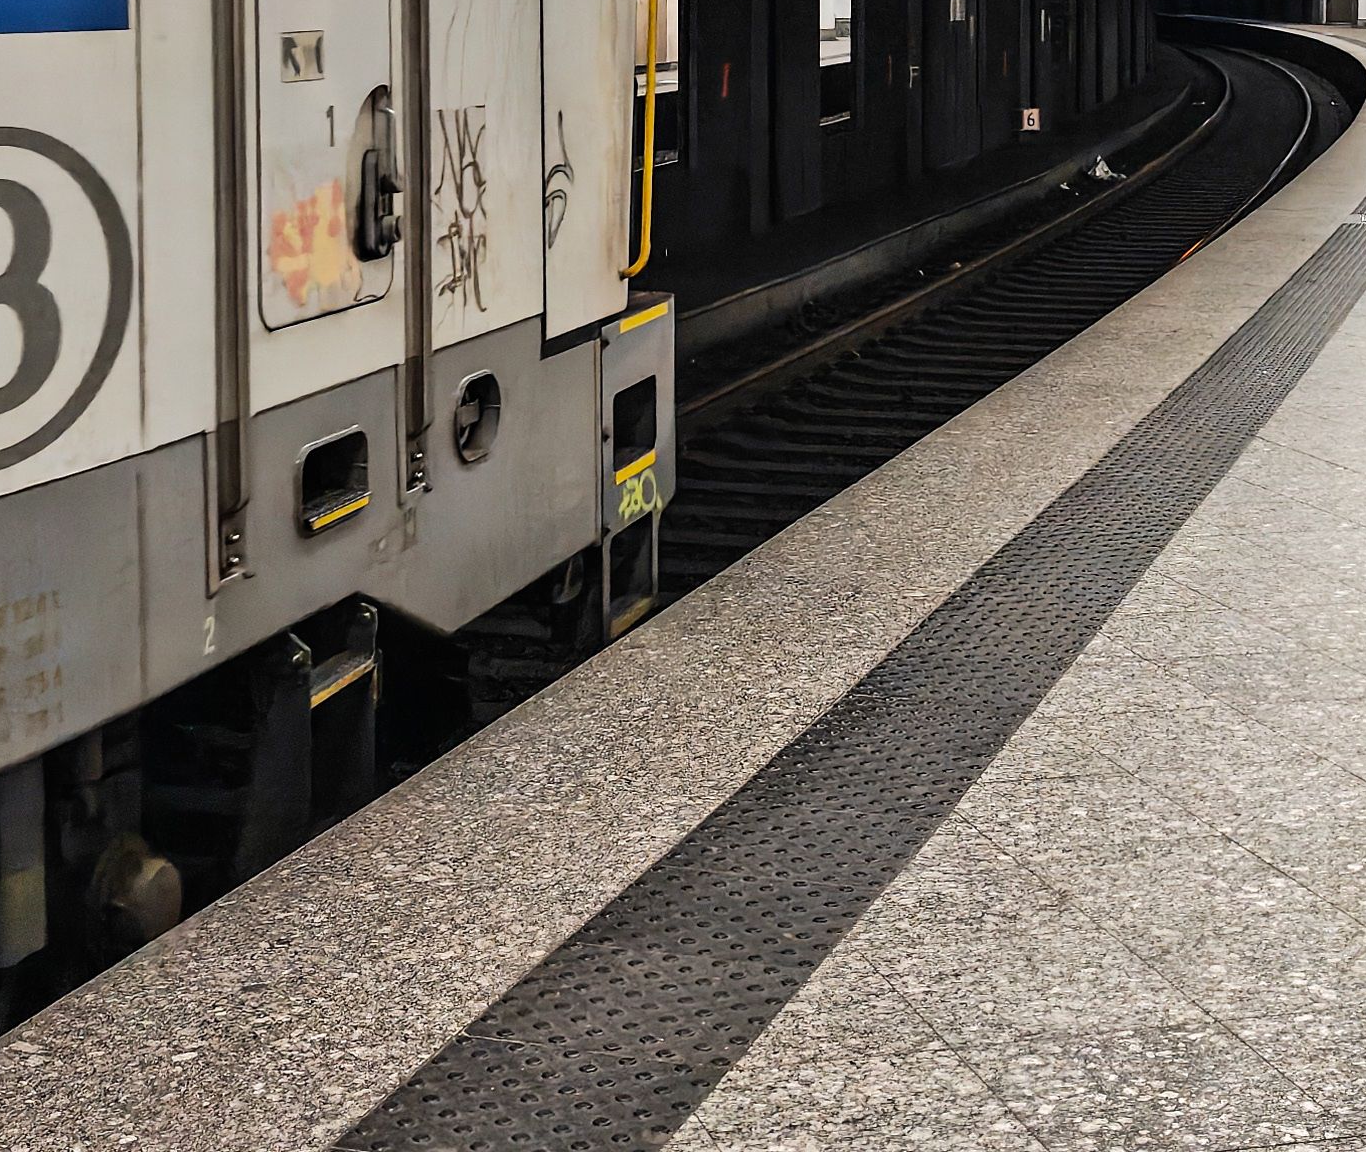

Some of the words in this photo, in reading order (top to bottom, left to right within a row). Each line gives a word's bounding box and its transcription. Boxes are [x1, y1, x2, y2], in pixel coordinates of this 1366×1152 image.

[326, 105, 335, 148] 1
[1027, 111, 1035, 127] 6
[203, 615, 216, 656] 2
